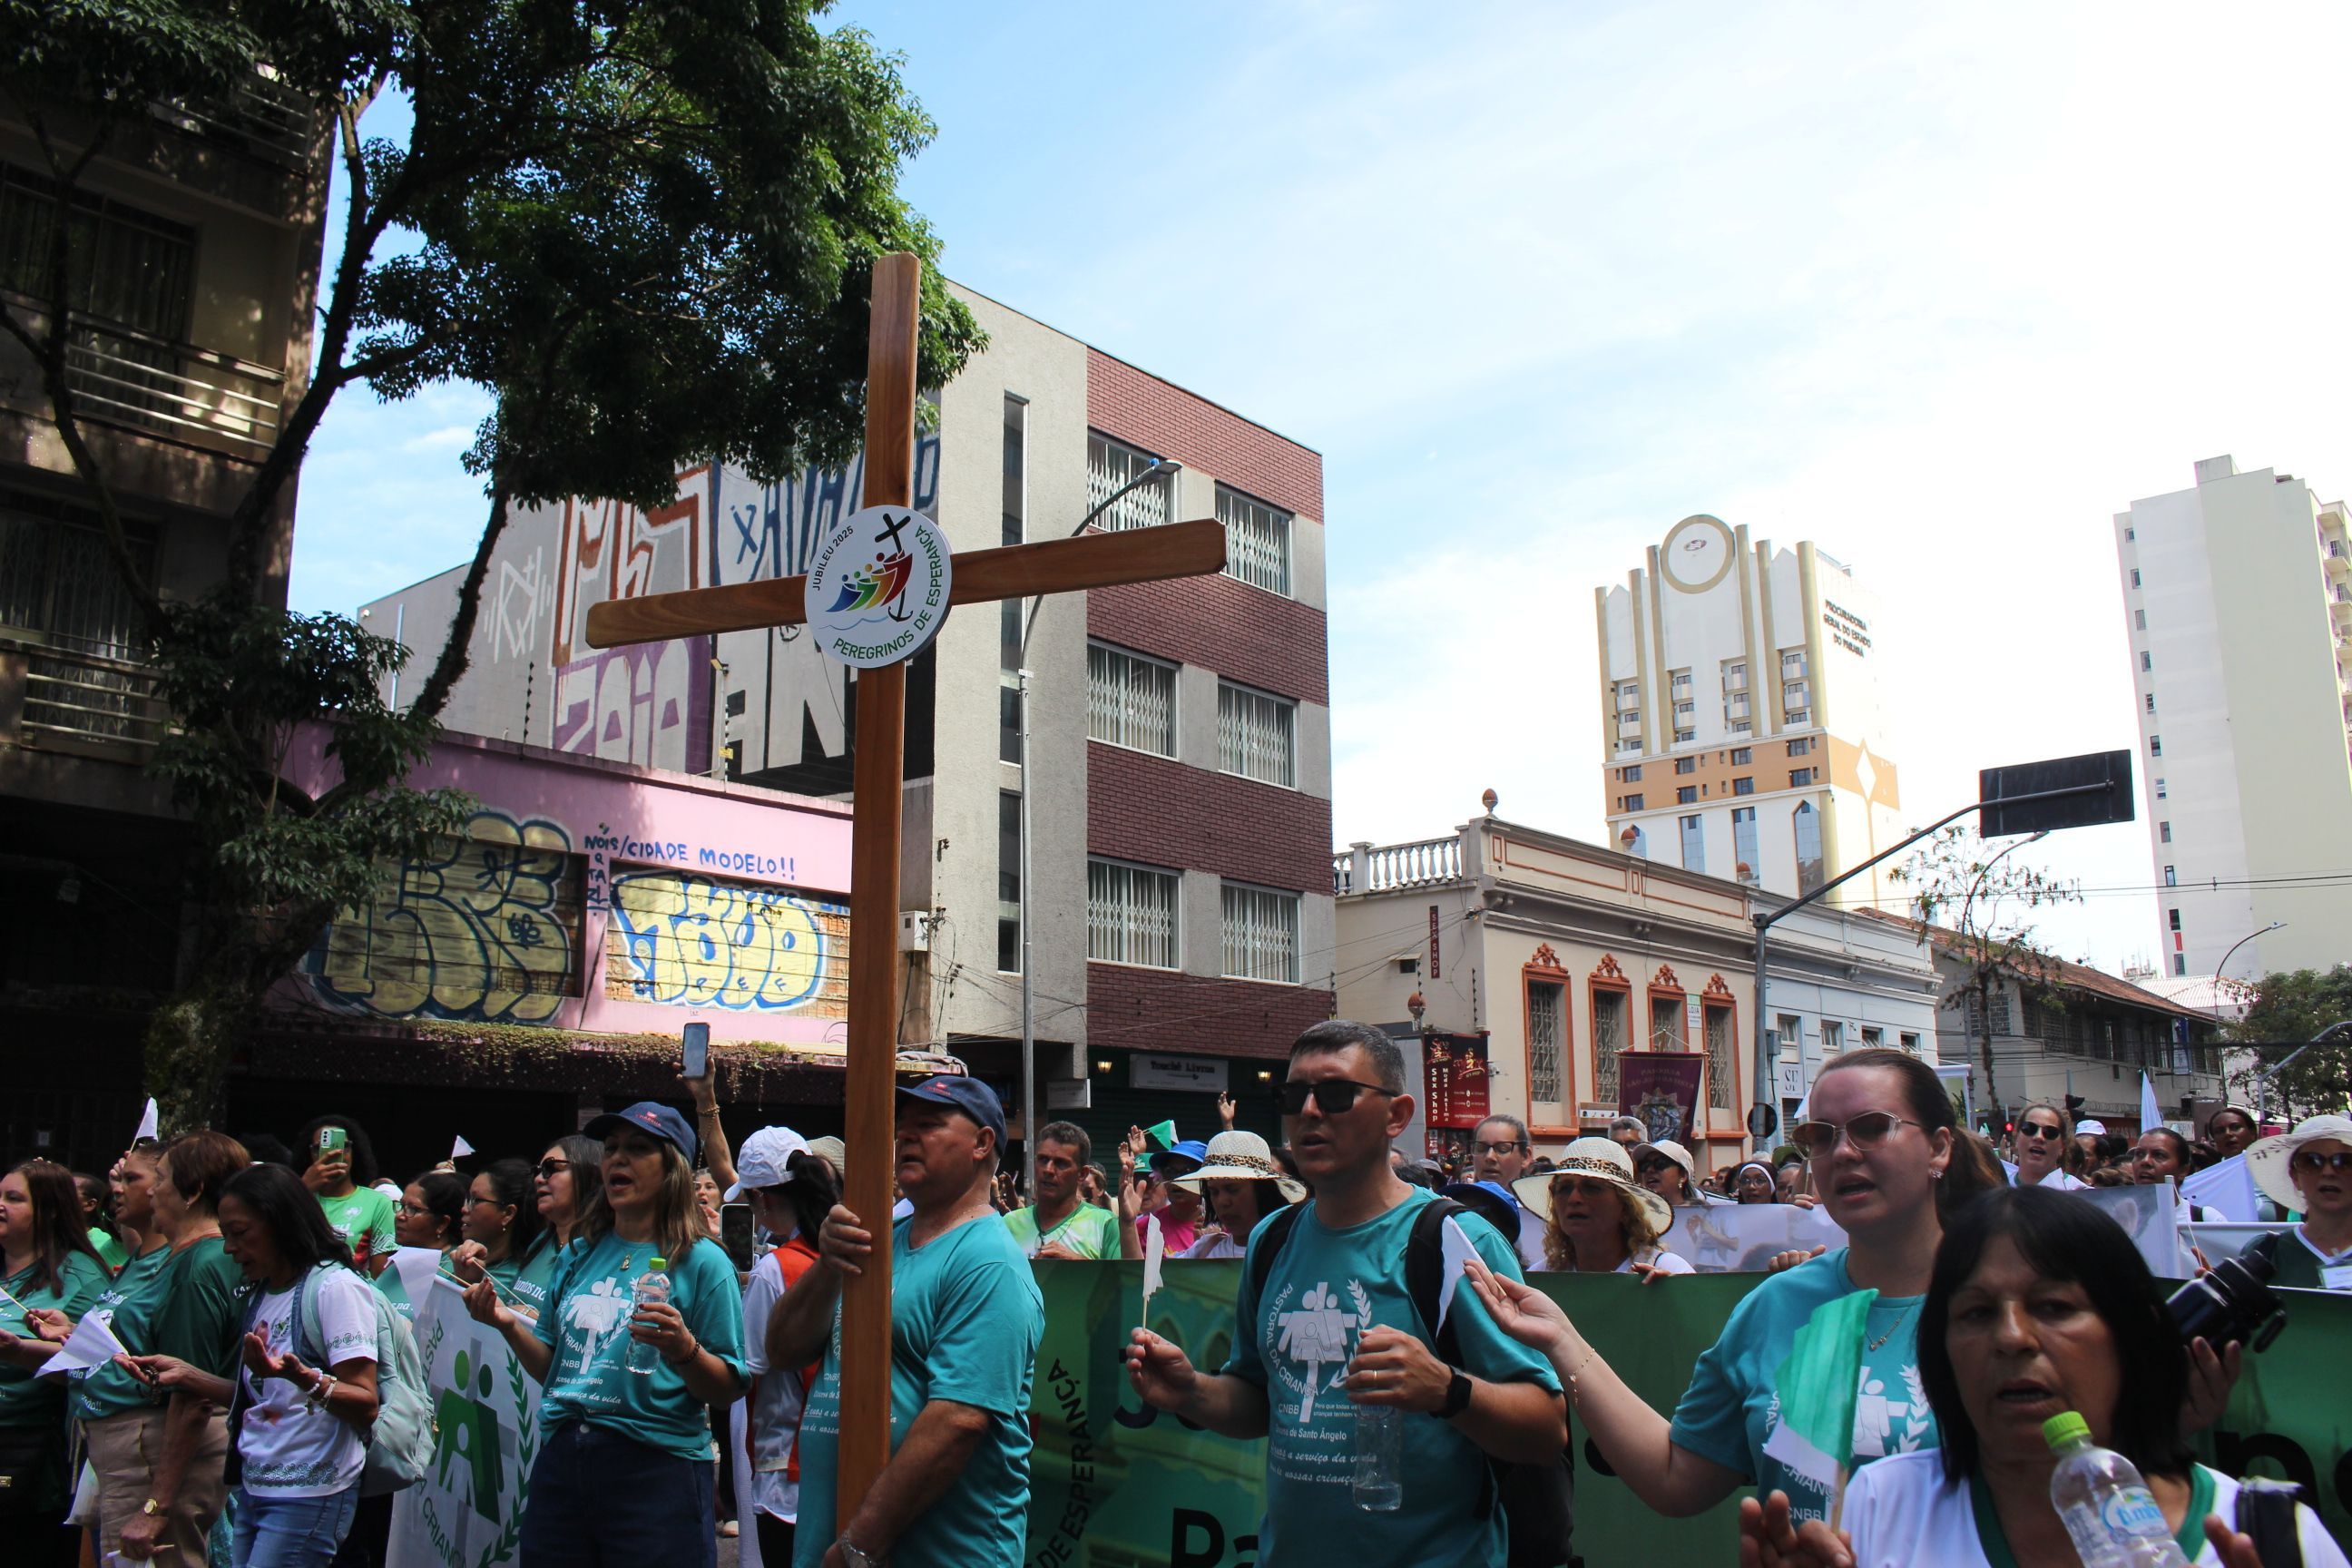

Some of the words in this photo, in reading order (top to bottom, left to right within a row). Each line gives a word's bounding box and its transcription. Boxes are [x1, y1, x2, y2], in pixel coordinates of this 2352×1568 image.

[812, 546, 834, 591] JUBILEU
[833, 525, 854, 547] 2025
[915, 524, 943, 607] ESPERANÇA
[913, 609, 932, 632] DE
[1842, 623, 1851, 637] DO
[833, 630, 915, 660] PEREGRINOS
[1833, 632, 1842, 645] DO
[1265, 1282, 1294, 1349] PASTORAL
[1269, 1348, 1281, 1369] DA
[589, 1390, 600, 1401] da
[602, 1394, 622, 1405] vida
[1278, 1403, 1299, 1416] CNBB
[1298, 1427, 1318, 1440] Santo
[1319, 1427, 1348, 1442] Ângelo
[1046, 1357, 1094, 1543] ESPERANÇA
[1295, 1452, 1329, 1465] serviço
[1331, 1452, 1347, 1463] da
